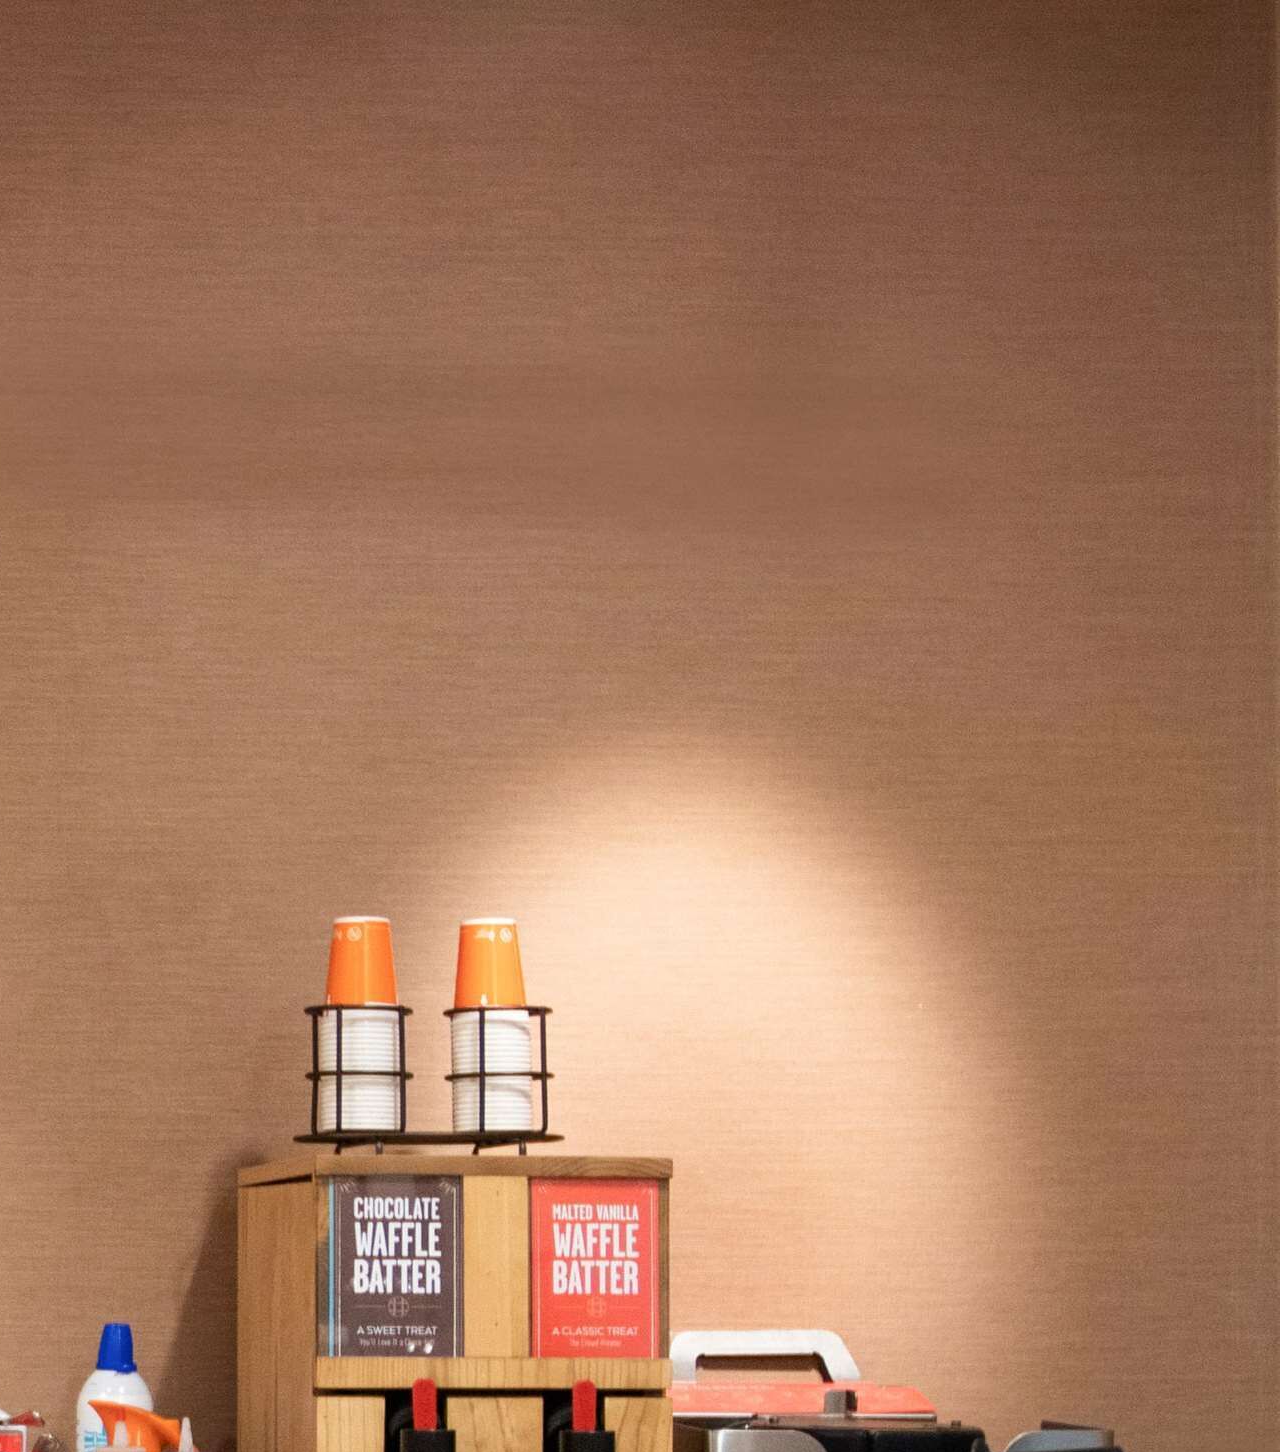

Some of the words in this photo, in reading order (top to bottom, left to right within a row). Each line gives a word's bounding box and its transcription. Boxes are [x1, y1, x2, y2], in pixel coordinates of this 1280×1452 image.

[353, 1197, 441, 1220] CHOCOLATE
[553, 1204, 593, 1220] MALTED
[596, 1204, 639, 1220] VANILLA
[354, 1222, 442, 1257] WAFFLE
[553, 1223, 640, 1257] WAFFLE
[353, 1259, 441, 1294] BATTER
[553, 1260, 639, 1295] BATTER
[356, 1325, 365, 1335] A
[366, 1325, 402, 1335] SWEET
[404, 1325, 438, 1335] TREAT
[562, 1326, 604, 1336] CLASSIC
[607, 1326, 639, 1336] TREAT
